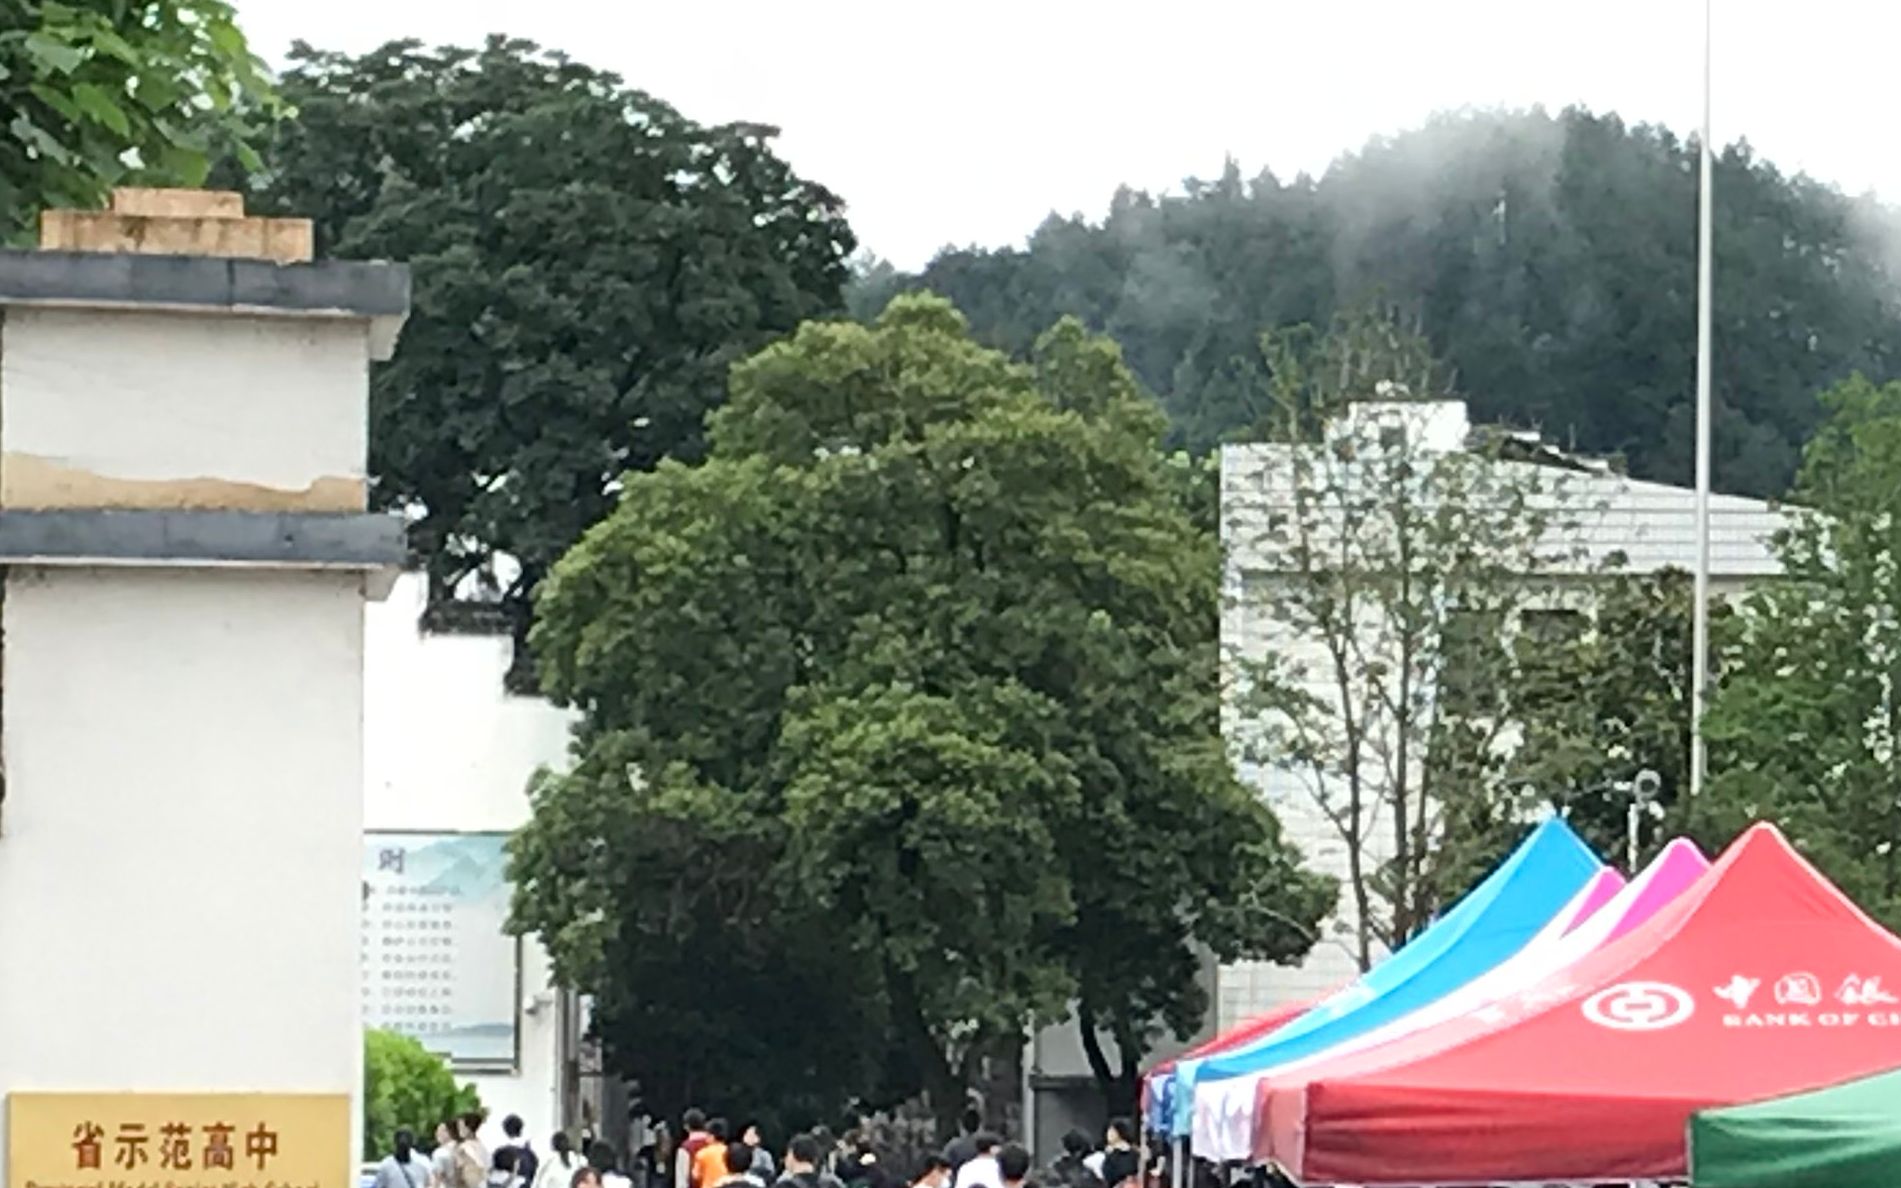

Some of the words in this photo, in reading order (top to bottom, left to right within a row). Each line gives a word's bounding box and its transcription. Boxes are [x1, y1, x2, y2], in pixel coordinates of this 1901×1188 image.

[1722, 1012, 1812, 1027] BANK
[1817, 1012, 1857, 1027] OF
[71, 1120, 279, 1171] 省示范高中
